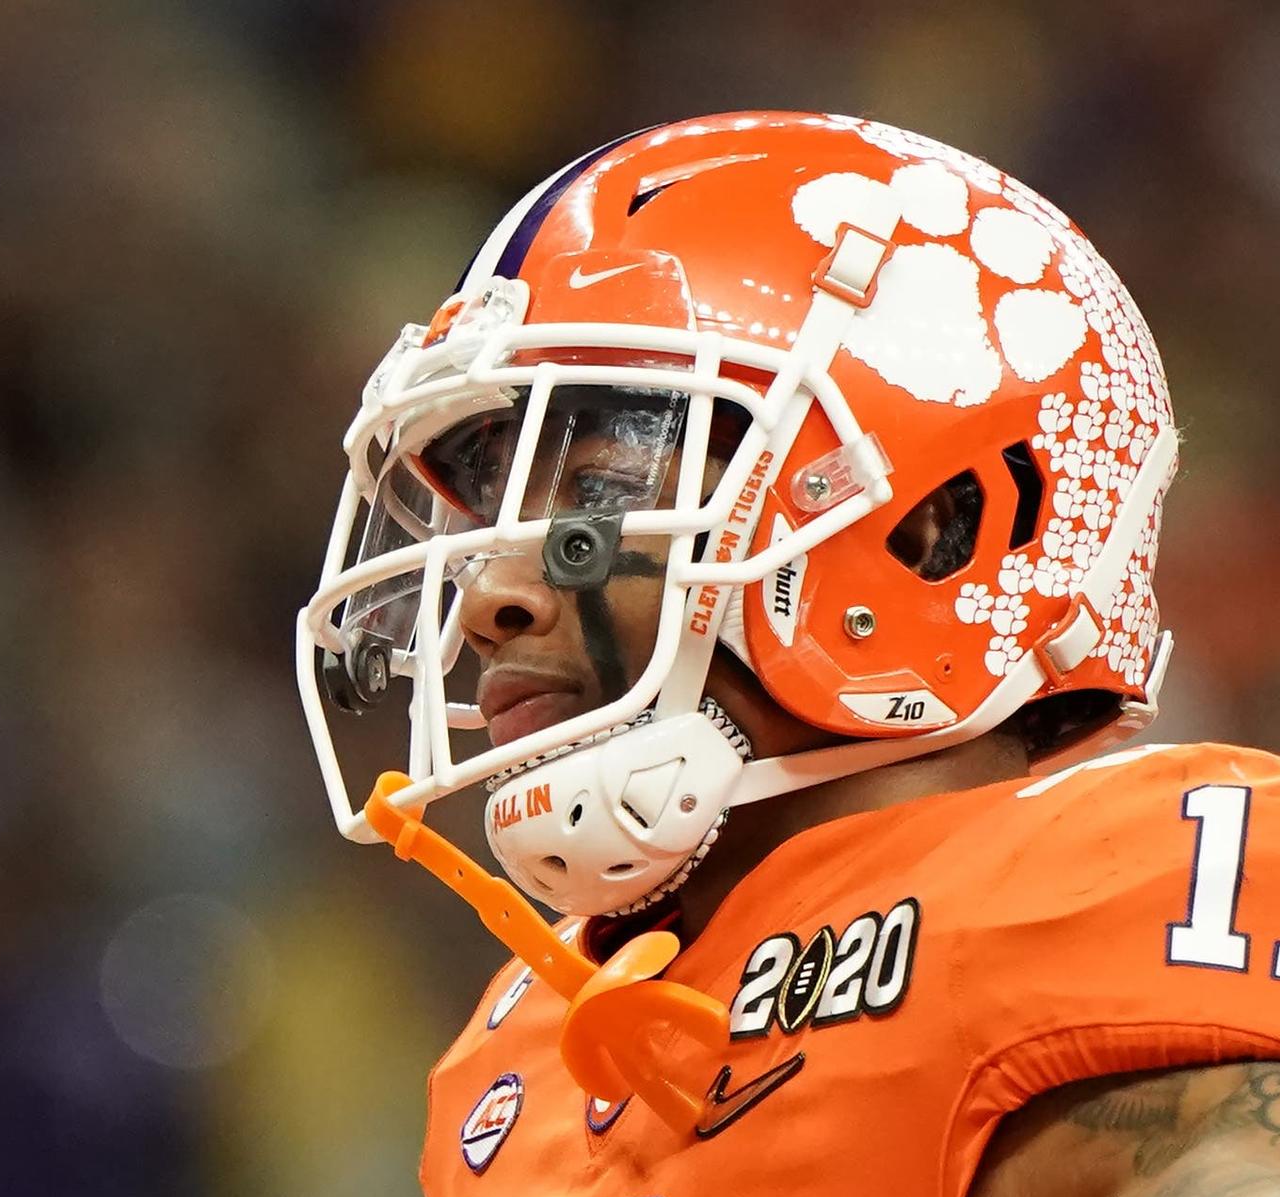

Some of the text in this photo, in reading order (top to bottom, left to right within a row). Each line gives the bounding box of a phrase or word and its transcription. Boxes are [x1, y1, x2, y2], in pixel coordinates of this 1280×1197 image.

[727, 449, 775, 525] TIGERS
[774, 560, 797, 618] hutt
[885, 695, 926, 721] Z10
[493, 783, 553, 835] ALL IN
